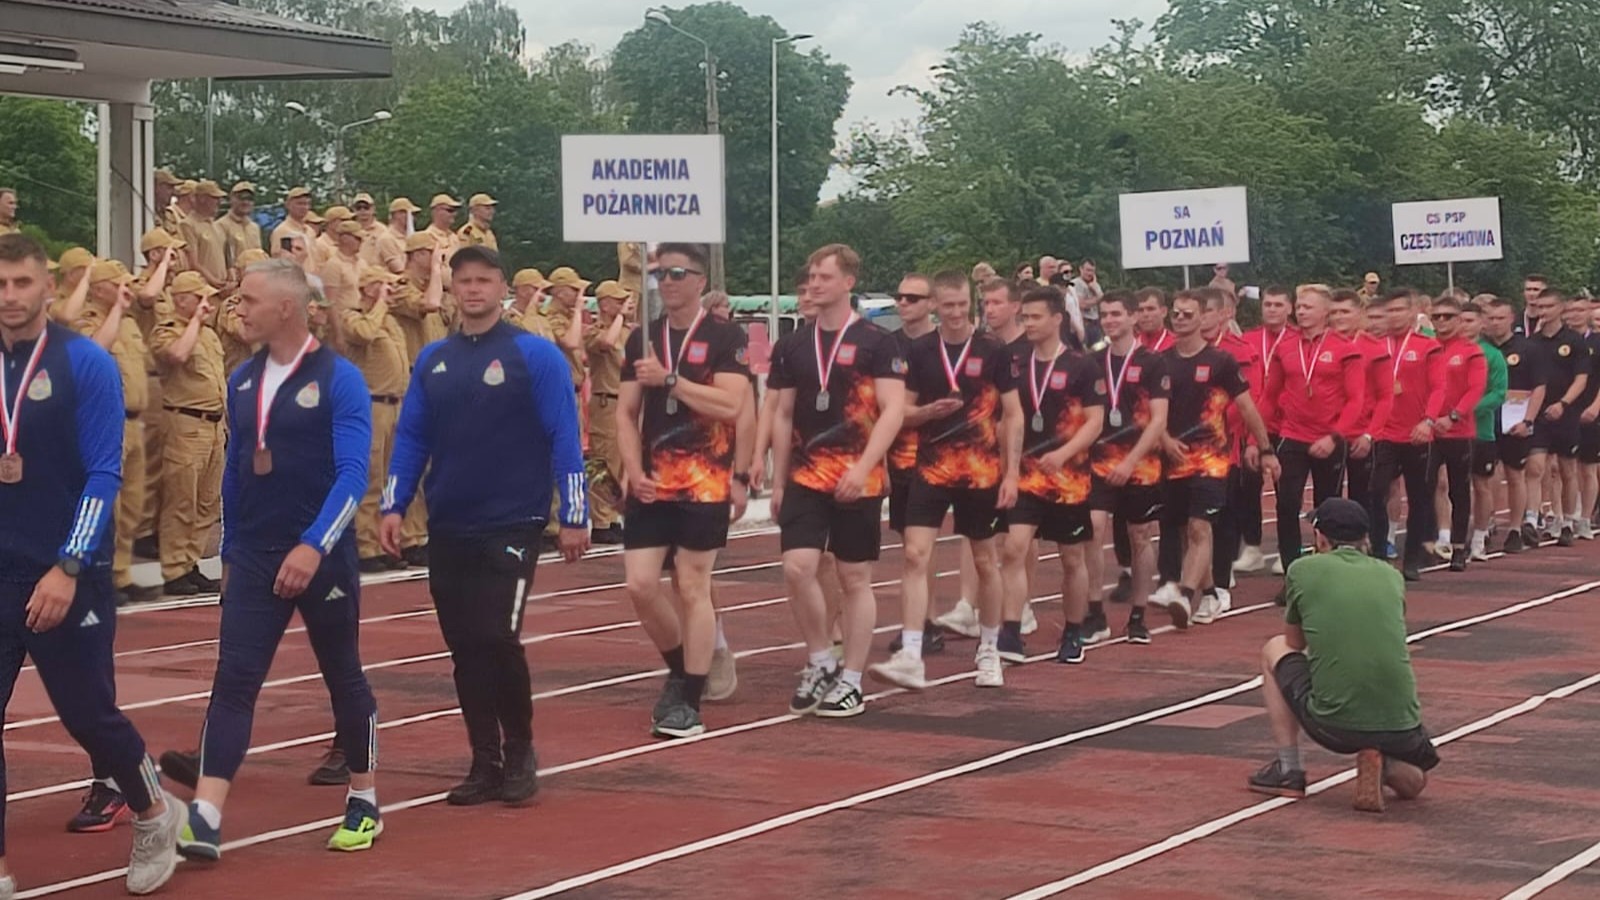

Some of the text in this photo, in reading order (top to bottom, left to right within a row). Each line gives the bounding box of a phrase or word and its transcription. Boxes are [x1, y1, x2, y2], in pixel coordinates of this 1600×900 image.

[592, 158, 690, 181] AKADEMIA
[582, 188, 700, 216] POŻARNICZA
[1173, 205, 1191, 219] SA
[1426, 212, 1466, 225] CS PSP
[1145, 220, 1225, 251] POZNAŃ
